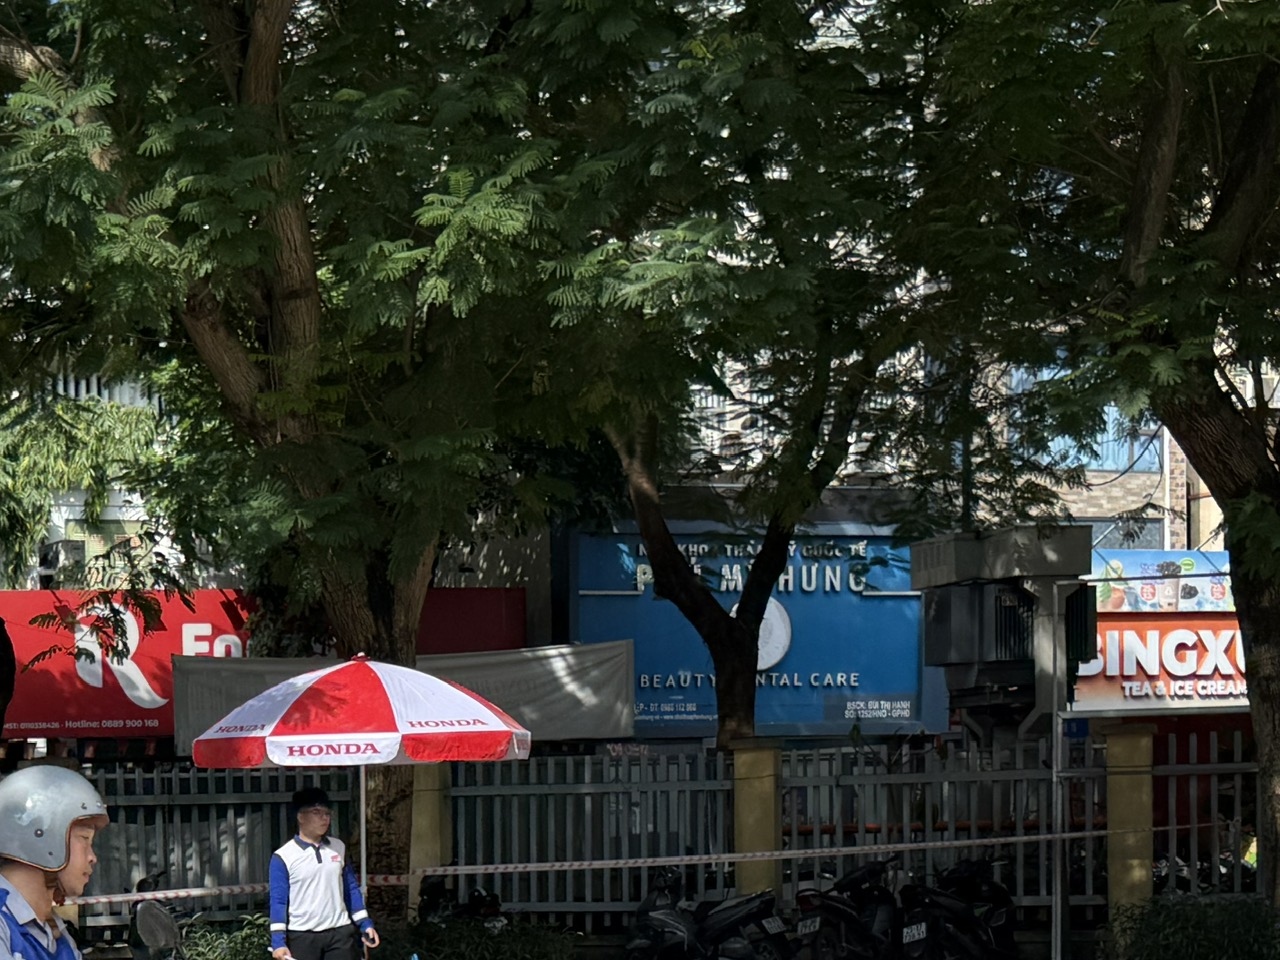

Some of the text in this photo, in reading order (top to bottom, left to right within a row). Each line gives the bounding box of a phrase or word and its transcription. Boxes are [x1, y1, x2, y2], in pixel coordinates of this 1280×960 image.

[848, 539, 867, 557] TẾ
[640, 673, 718, 687] BEAUTY
[810, 673, 860, 687] CARE
[1122, 680, 1153, 695] TEA
[1171, 680, 1194, 695] ICE
[65, 720, 99, 728] Hotline:
[125, 719, 142, 728] 900
[144, 719, 159, 727] 168
[214, 724, 266, 733] HONDA
[408, 718, 489, 728] HONDA
[287, 743, 381, 757] HONDA
